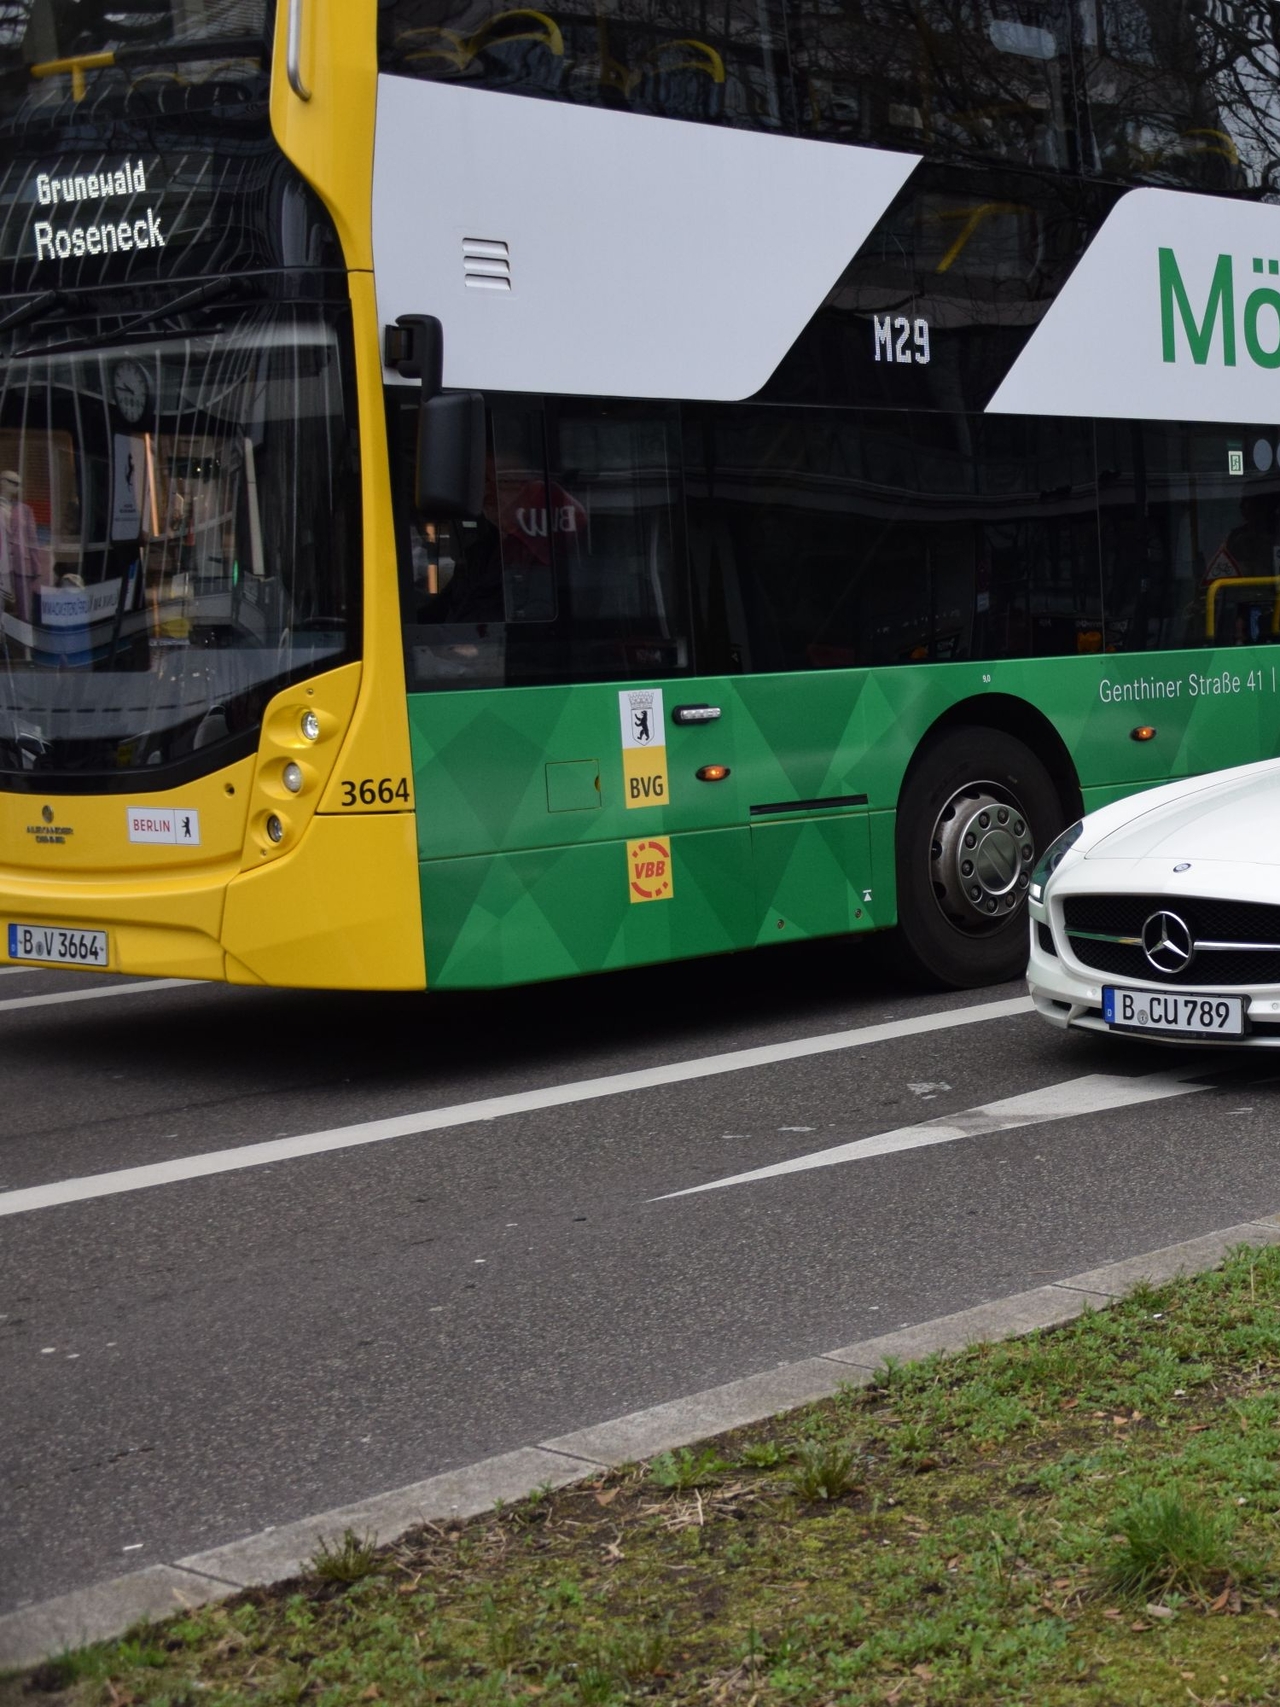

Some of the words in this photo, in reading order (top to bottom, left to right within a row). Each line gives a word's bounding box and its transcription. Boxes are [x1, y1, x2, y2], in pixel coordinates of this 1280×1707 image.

[37, 159, 146, 205] Grunewald
[34, 208, 165, 261] Roseneck
[873, 315, 930, 364] M29
[1100, 676, 1182, 703] Genthiner
[1188, 671, 1240, 697] Straße
[1246, 670, 1263, 692] 41
[340, 777, 411, 806] 3664
[629, 775, 664, 799] BVG
[133, 819, 171, 833] BERLIN
[634, 860, 666, 880] VBB
[23, 929, 34, 955] B
[44, 931, 54, 957] V
[58, 932, 100, 960] 3664
[1122, 994, 1135, 1021] B
